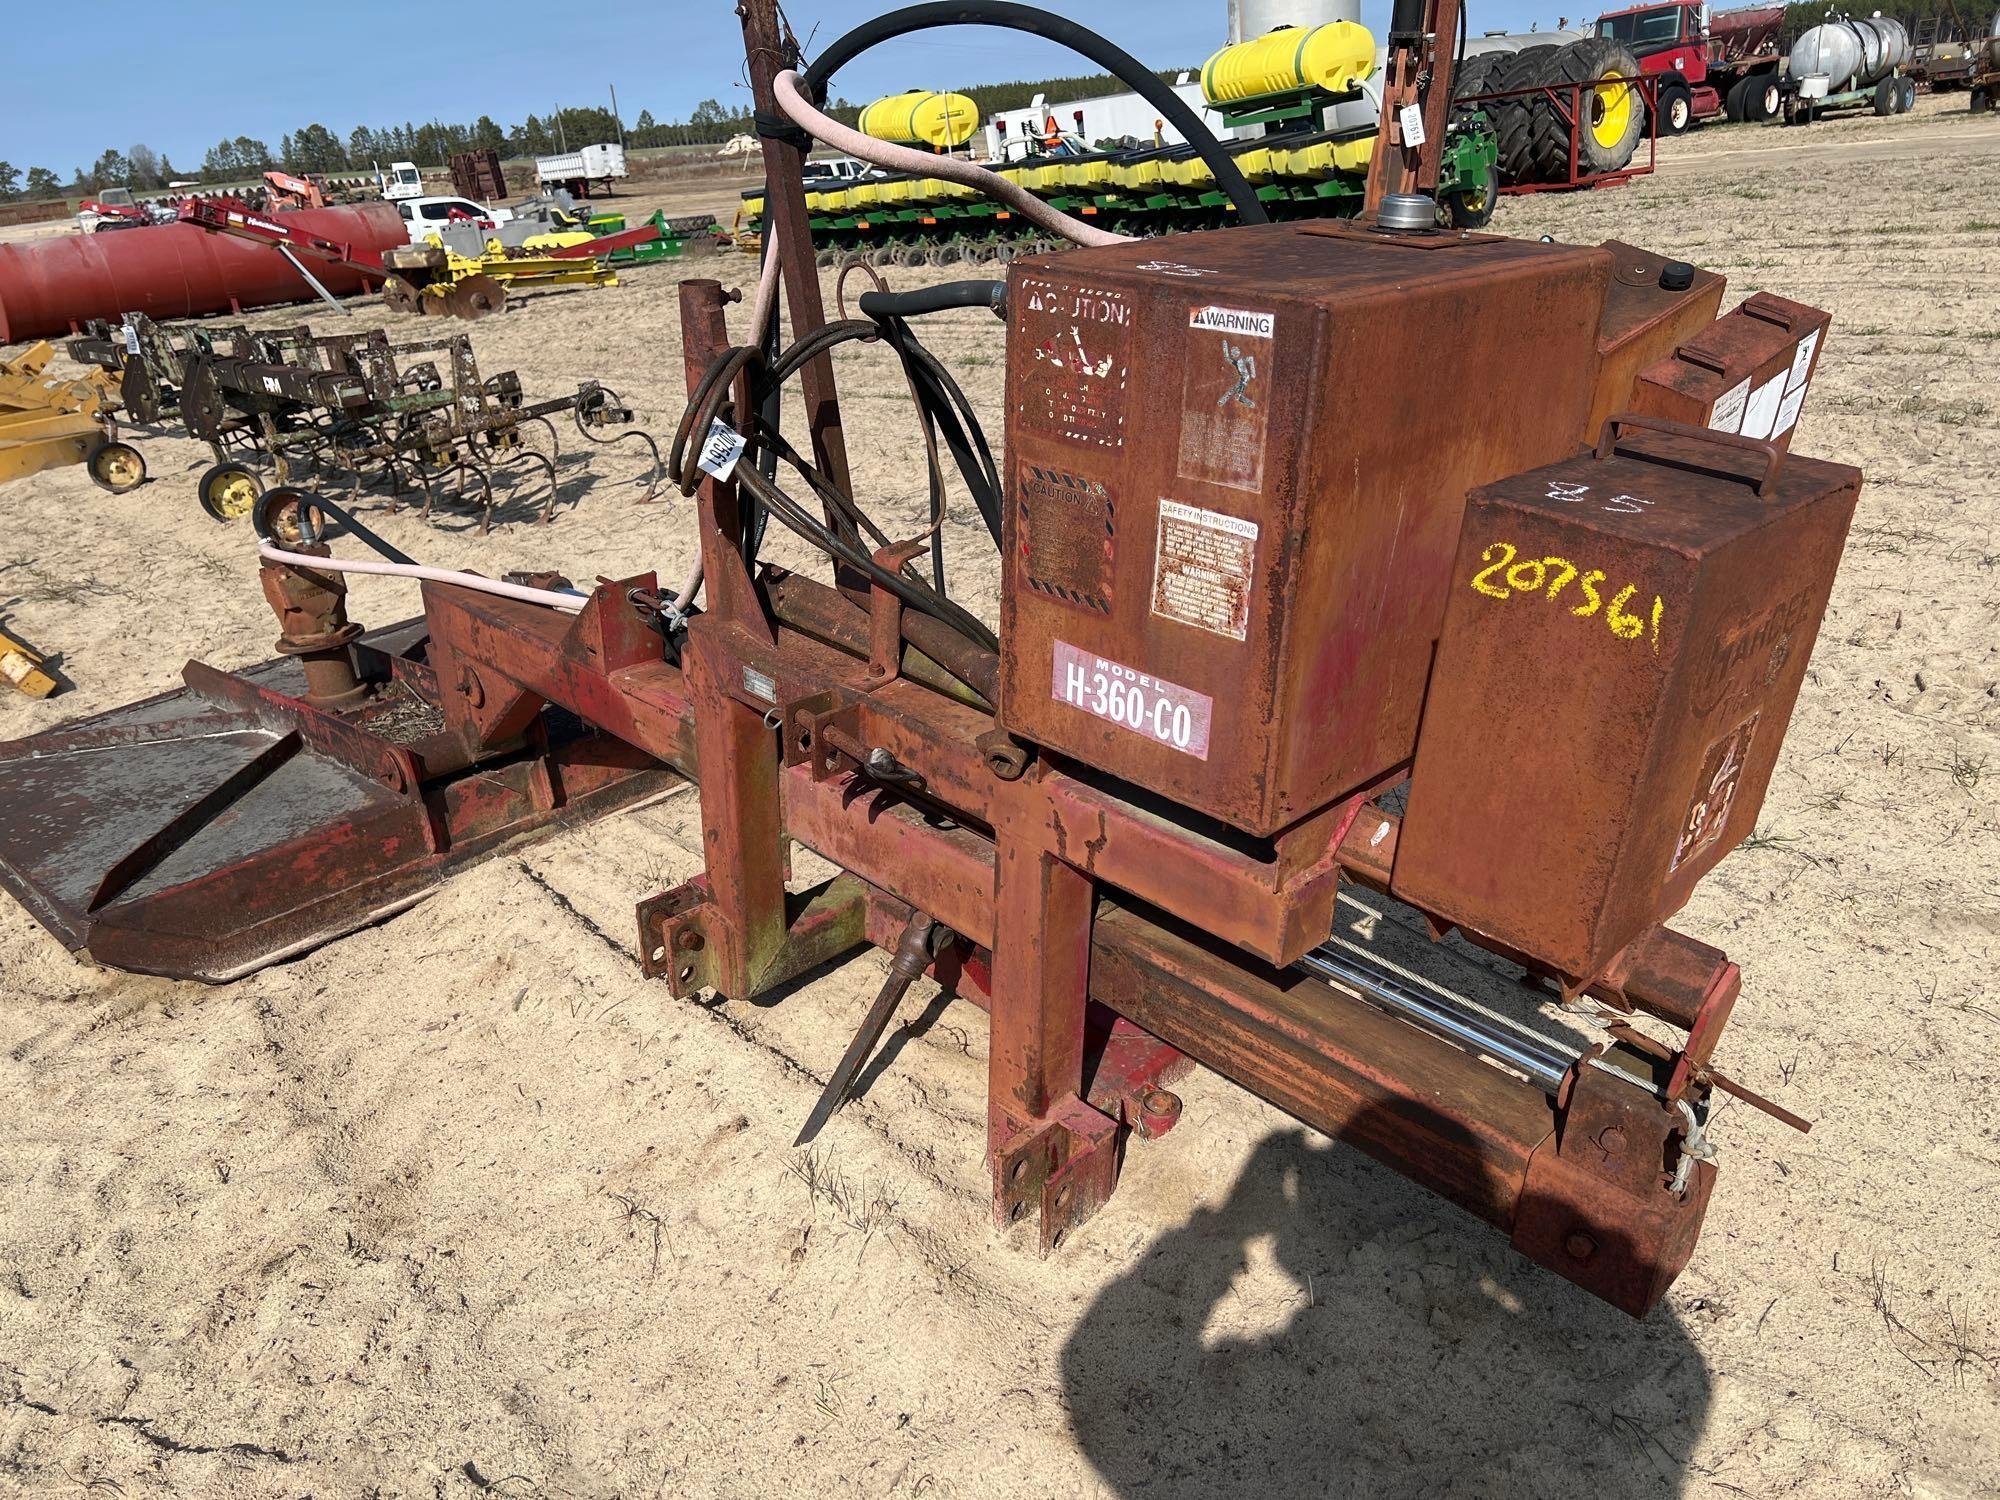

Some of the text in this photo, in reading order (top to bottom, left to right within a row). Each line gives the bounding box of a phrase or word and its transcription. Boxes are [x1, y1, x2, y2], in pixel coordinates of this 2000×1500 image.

[1206, 311, 1270, 334] WARNING
[705, 428, 737, 469] 207561
[1033, 482, 1081, 505] CAUTION
[1161, 503, 1256, 537] SAFETY INSTRUCTIONS
[1182, 564, 1220, 583] WARNING
[1470, 542, 1664, 656] 207561
[1096, 658, 1166, 693] MODEL
[1066, 662, 1192, 748] H-360-CO
